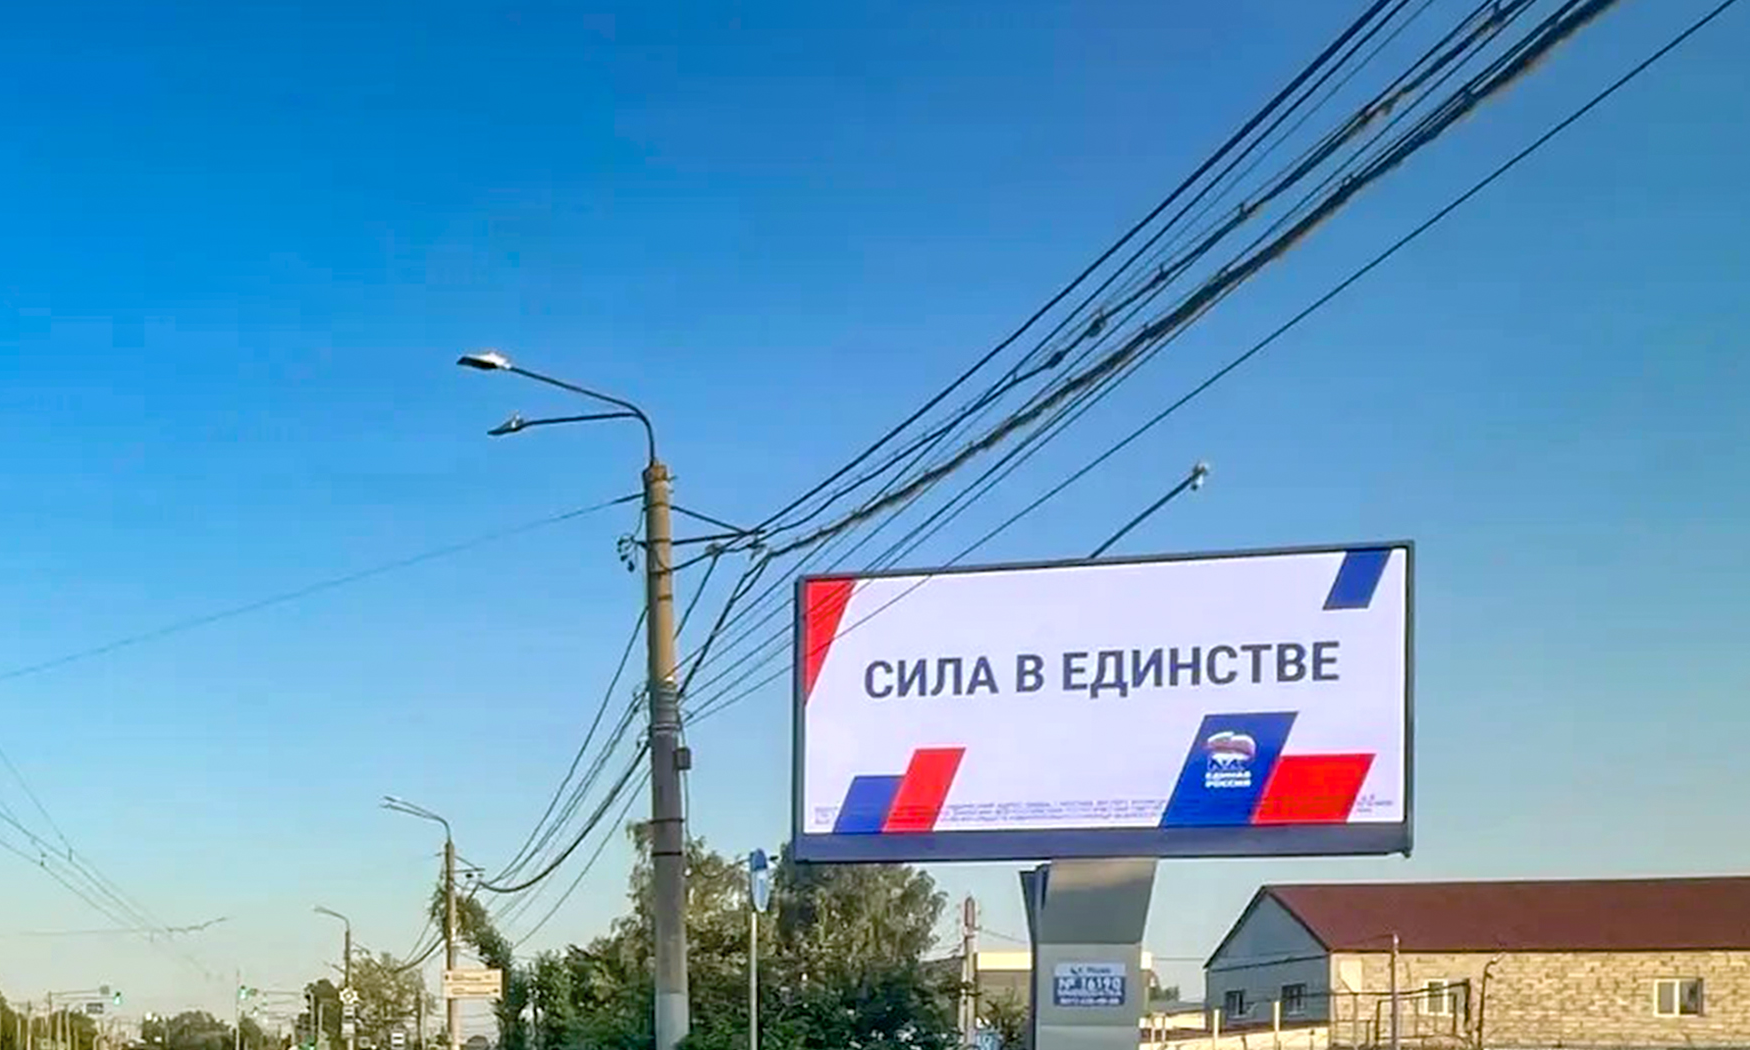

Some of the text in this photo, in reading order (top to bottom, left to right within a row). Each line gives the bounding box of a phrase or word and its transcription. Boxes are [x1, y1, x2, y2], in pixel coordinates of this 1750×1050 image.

[864, 641, 1340, 699] СИЛА В ЕДИНСТВЕ
